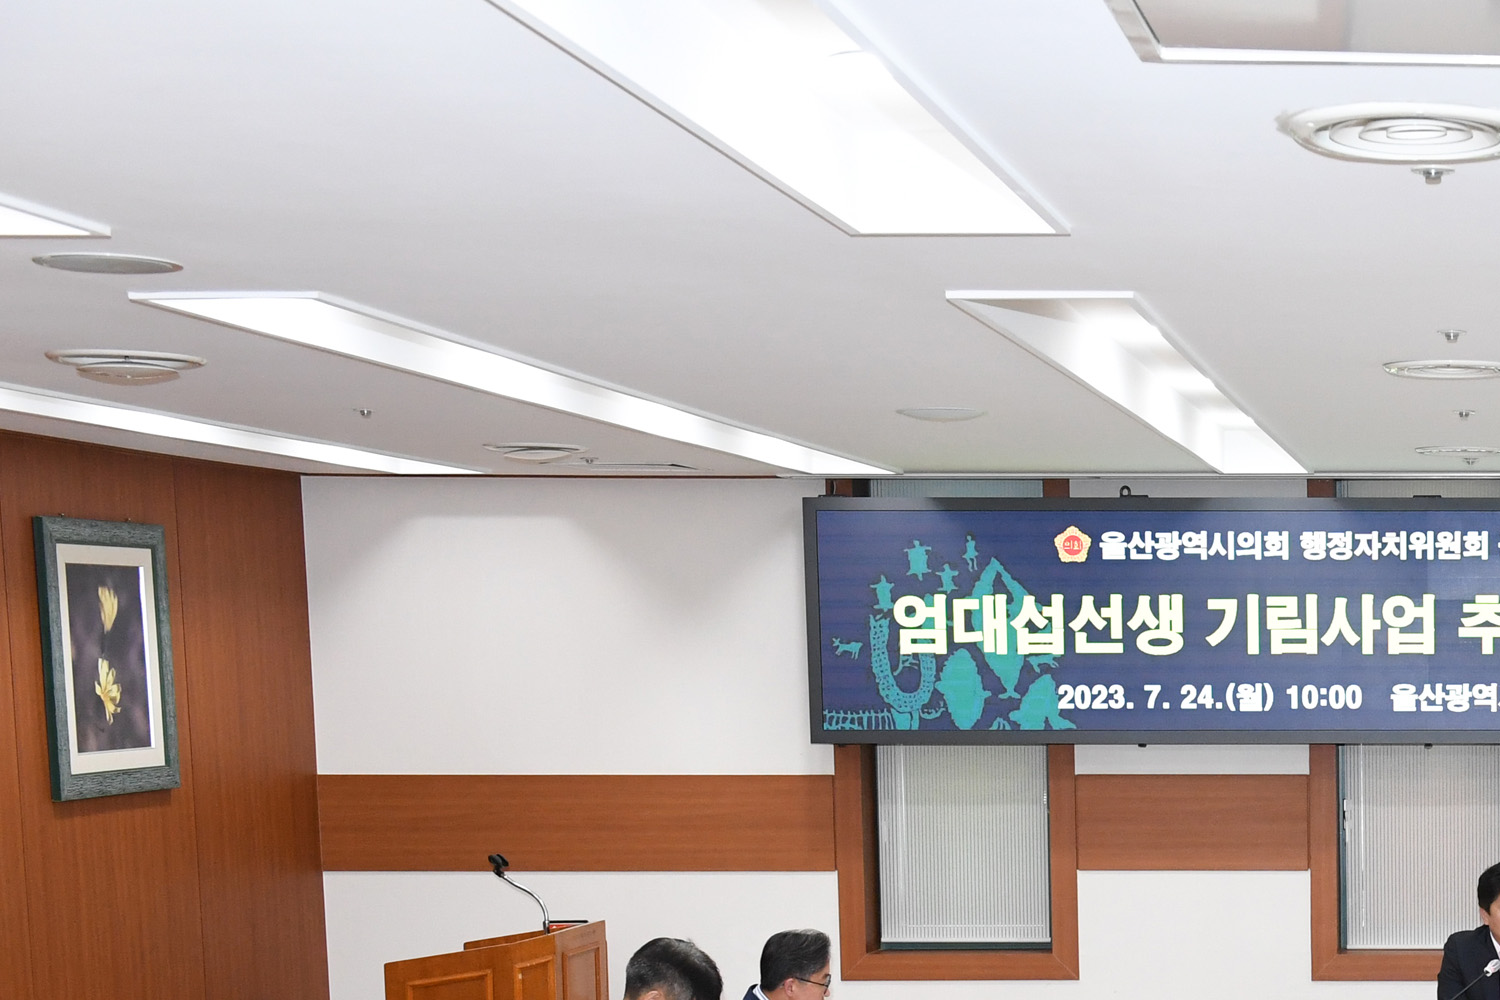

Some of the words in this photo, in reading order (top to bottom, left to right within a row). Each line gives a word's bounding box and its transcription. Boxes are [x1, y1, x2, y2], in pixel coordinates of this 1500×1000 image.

[1099, 530, 1289, 561] 울산광역시의회
[1299, 530, 1489, 561] 행정자치위원회
[893, 593, 1185, 656] 엄대섭선생
[1205, 593, 1436, 656] 기림사업
[1057, 684, 1135, 710] 2023.
[1144, 684, 1171, 710] 7.
[1180, 683, 1275, 712] 24.(월)
[1286, 684, 1363, 710] 10:00
